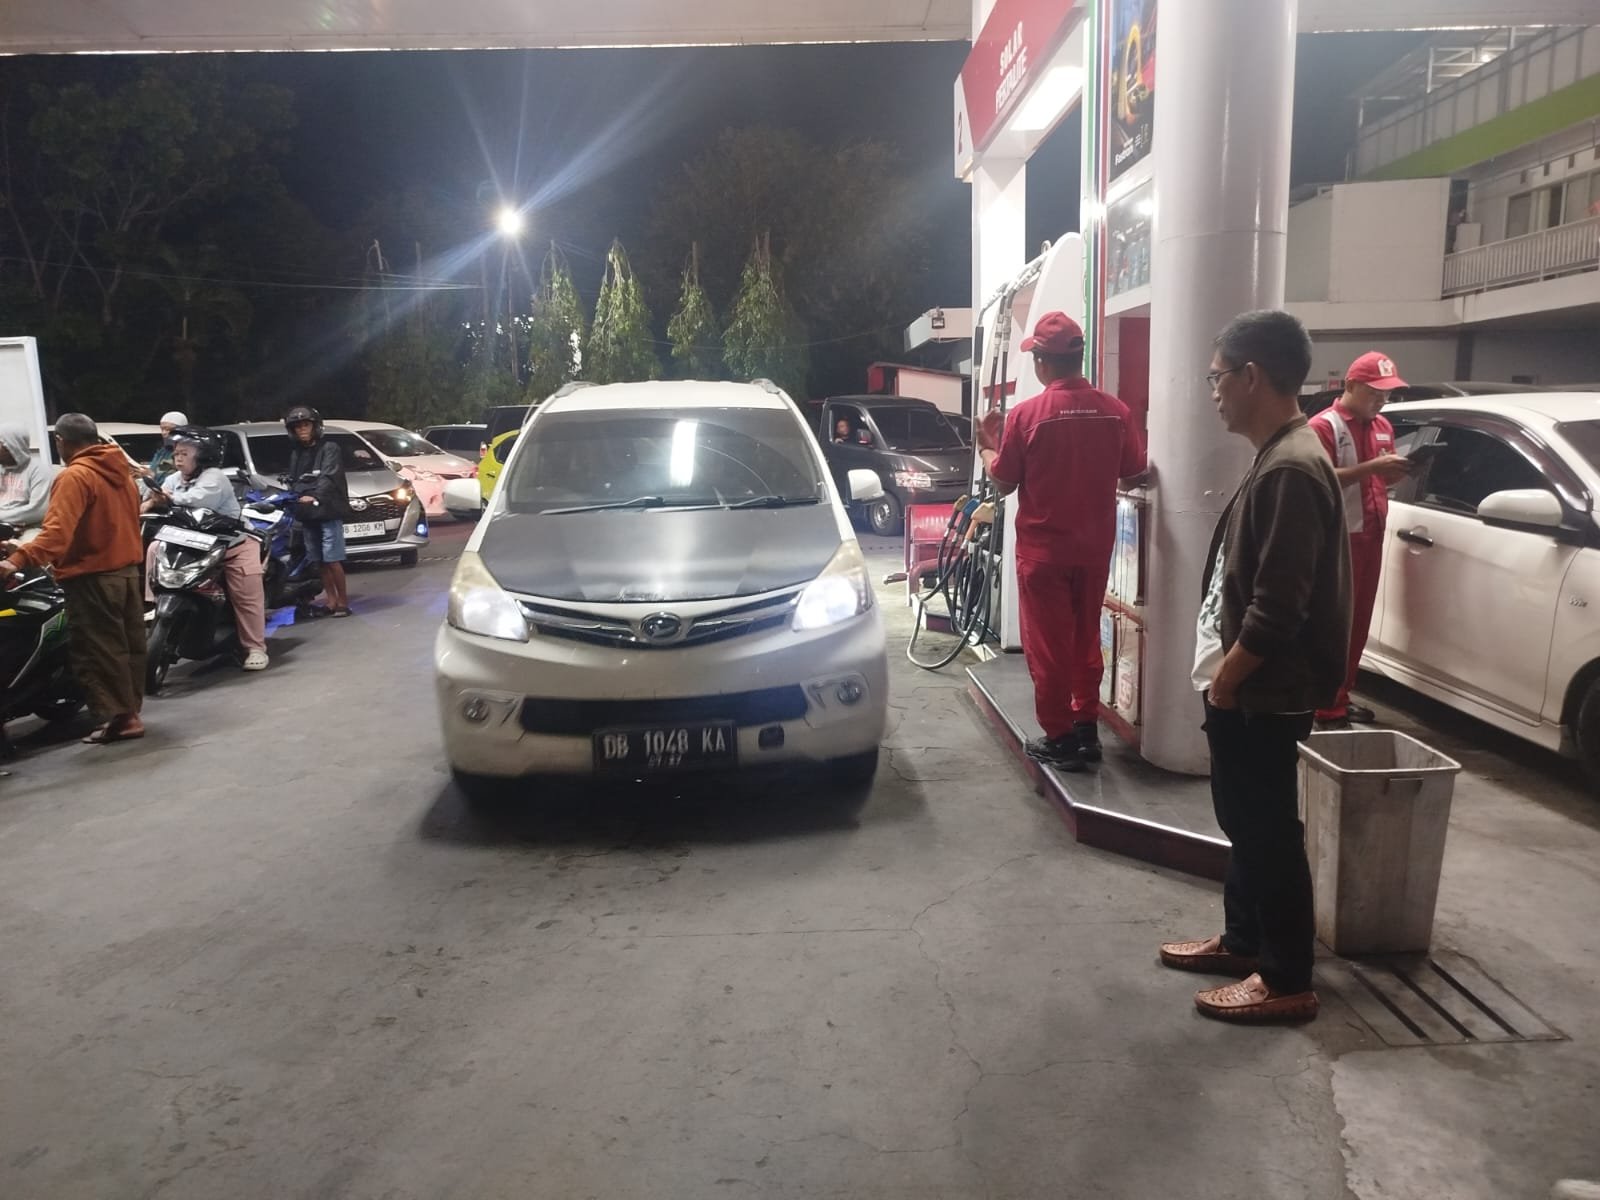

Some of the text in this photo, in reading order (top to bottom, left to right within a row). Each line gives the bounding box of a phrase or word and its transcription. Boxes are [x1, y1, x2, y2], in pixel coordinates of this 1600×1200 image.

[1000, 21, 1023, 77] SOLAR
[603, 727, 726, 759] DB 1048 KA
